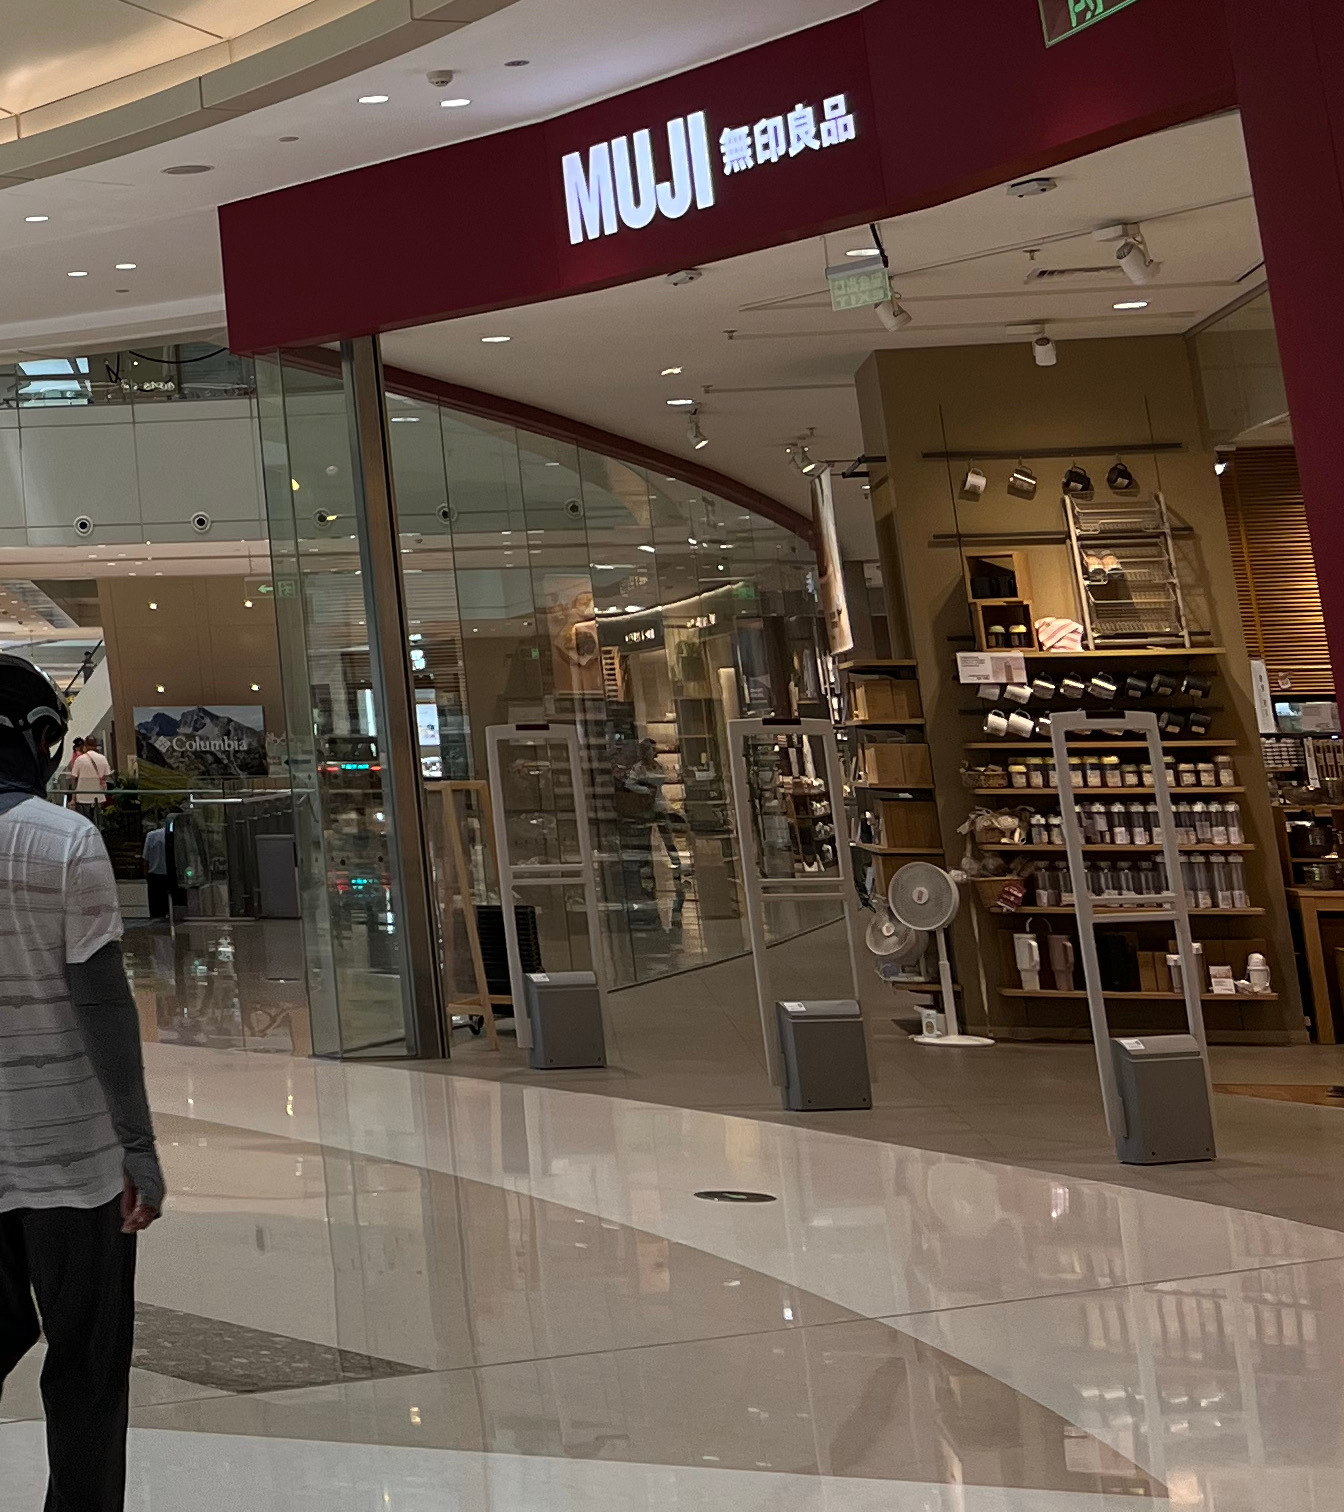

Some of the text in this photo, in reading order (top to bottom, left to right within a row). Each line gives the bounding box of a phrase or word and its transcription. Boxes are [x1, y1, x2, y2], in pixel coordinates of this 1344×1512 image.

[562, 94, 856, 245] MUJI 無印良品
[172, 736, 248, 751] Columbia
